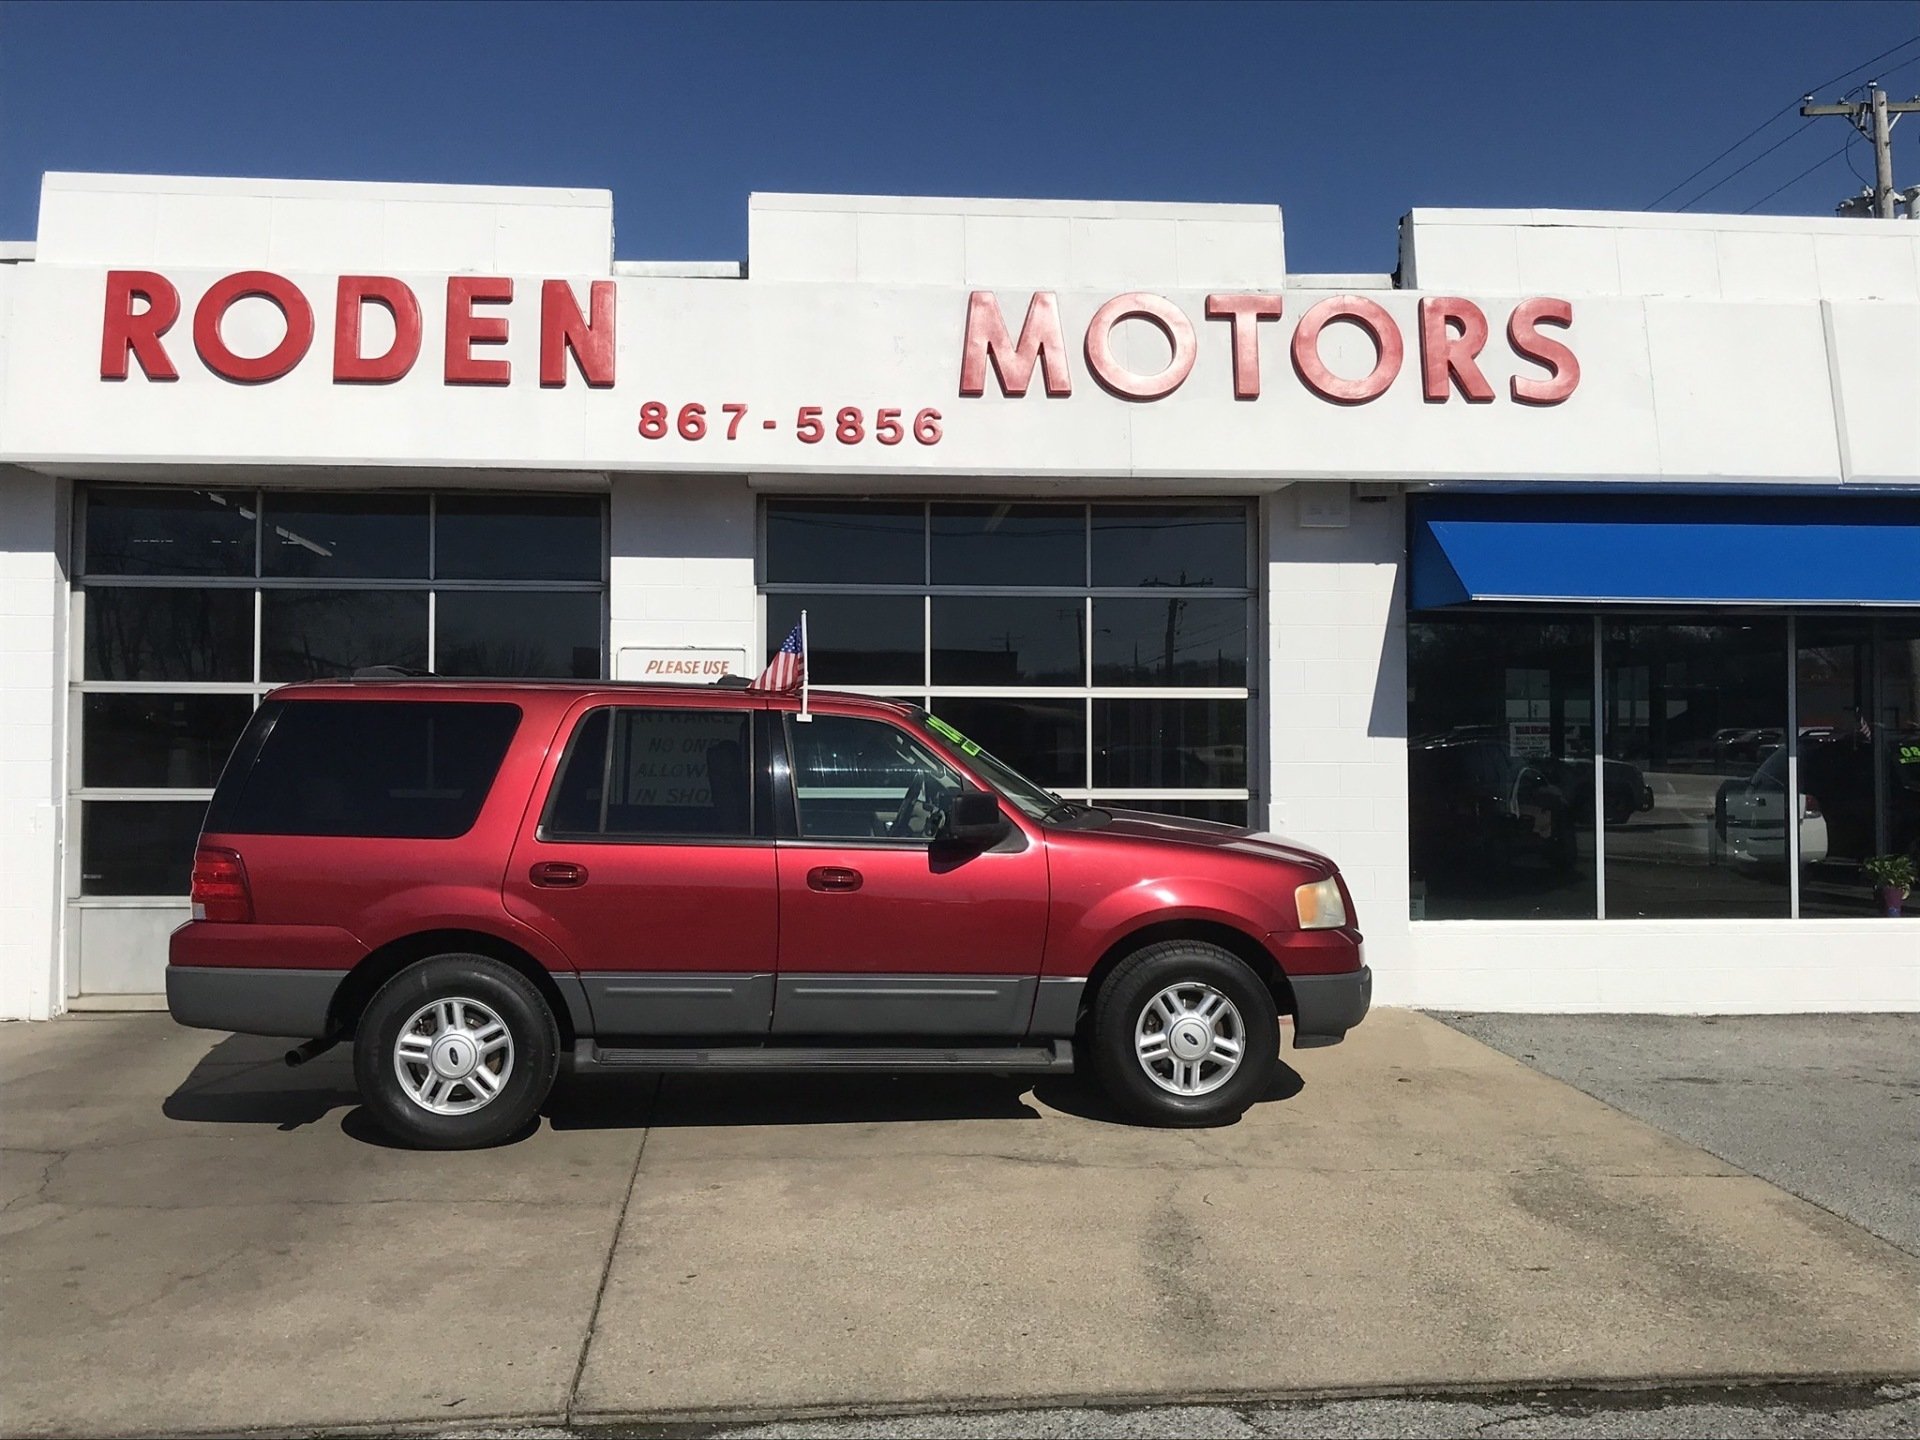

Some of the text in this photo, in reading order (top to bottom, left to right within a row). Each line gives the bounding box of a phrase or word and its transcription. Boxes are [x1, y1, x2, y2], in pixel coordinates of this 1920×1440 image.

[101, 271, 1581, 404] RODEN MOTORS
[639, 403, 942, 444] 867-5856
[645, 660, 729, 674] PLEASE USE
[648, 737, 674, 753] NO
